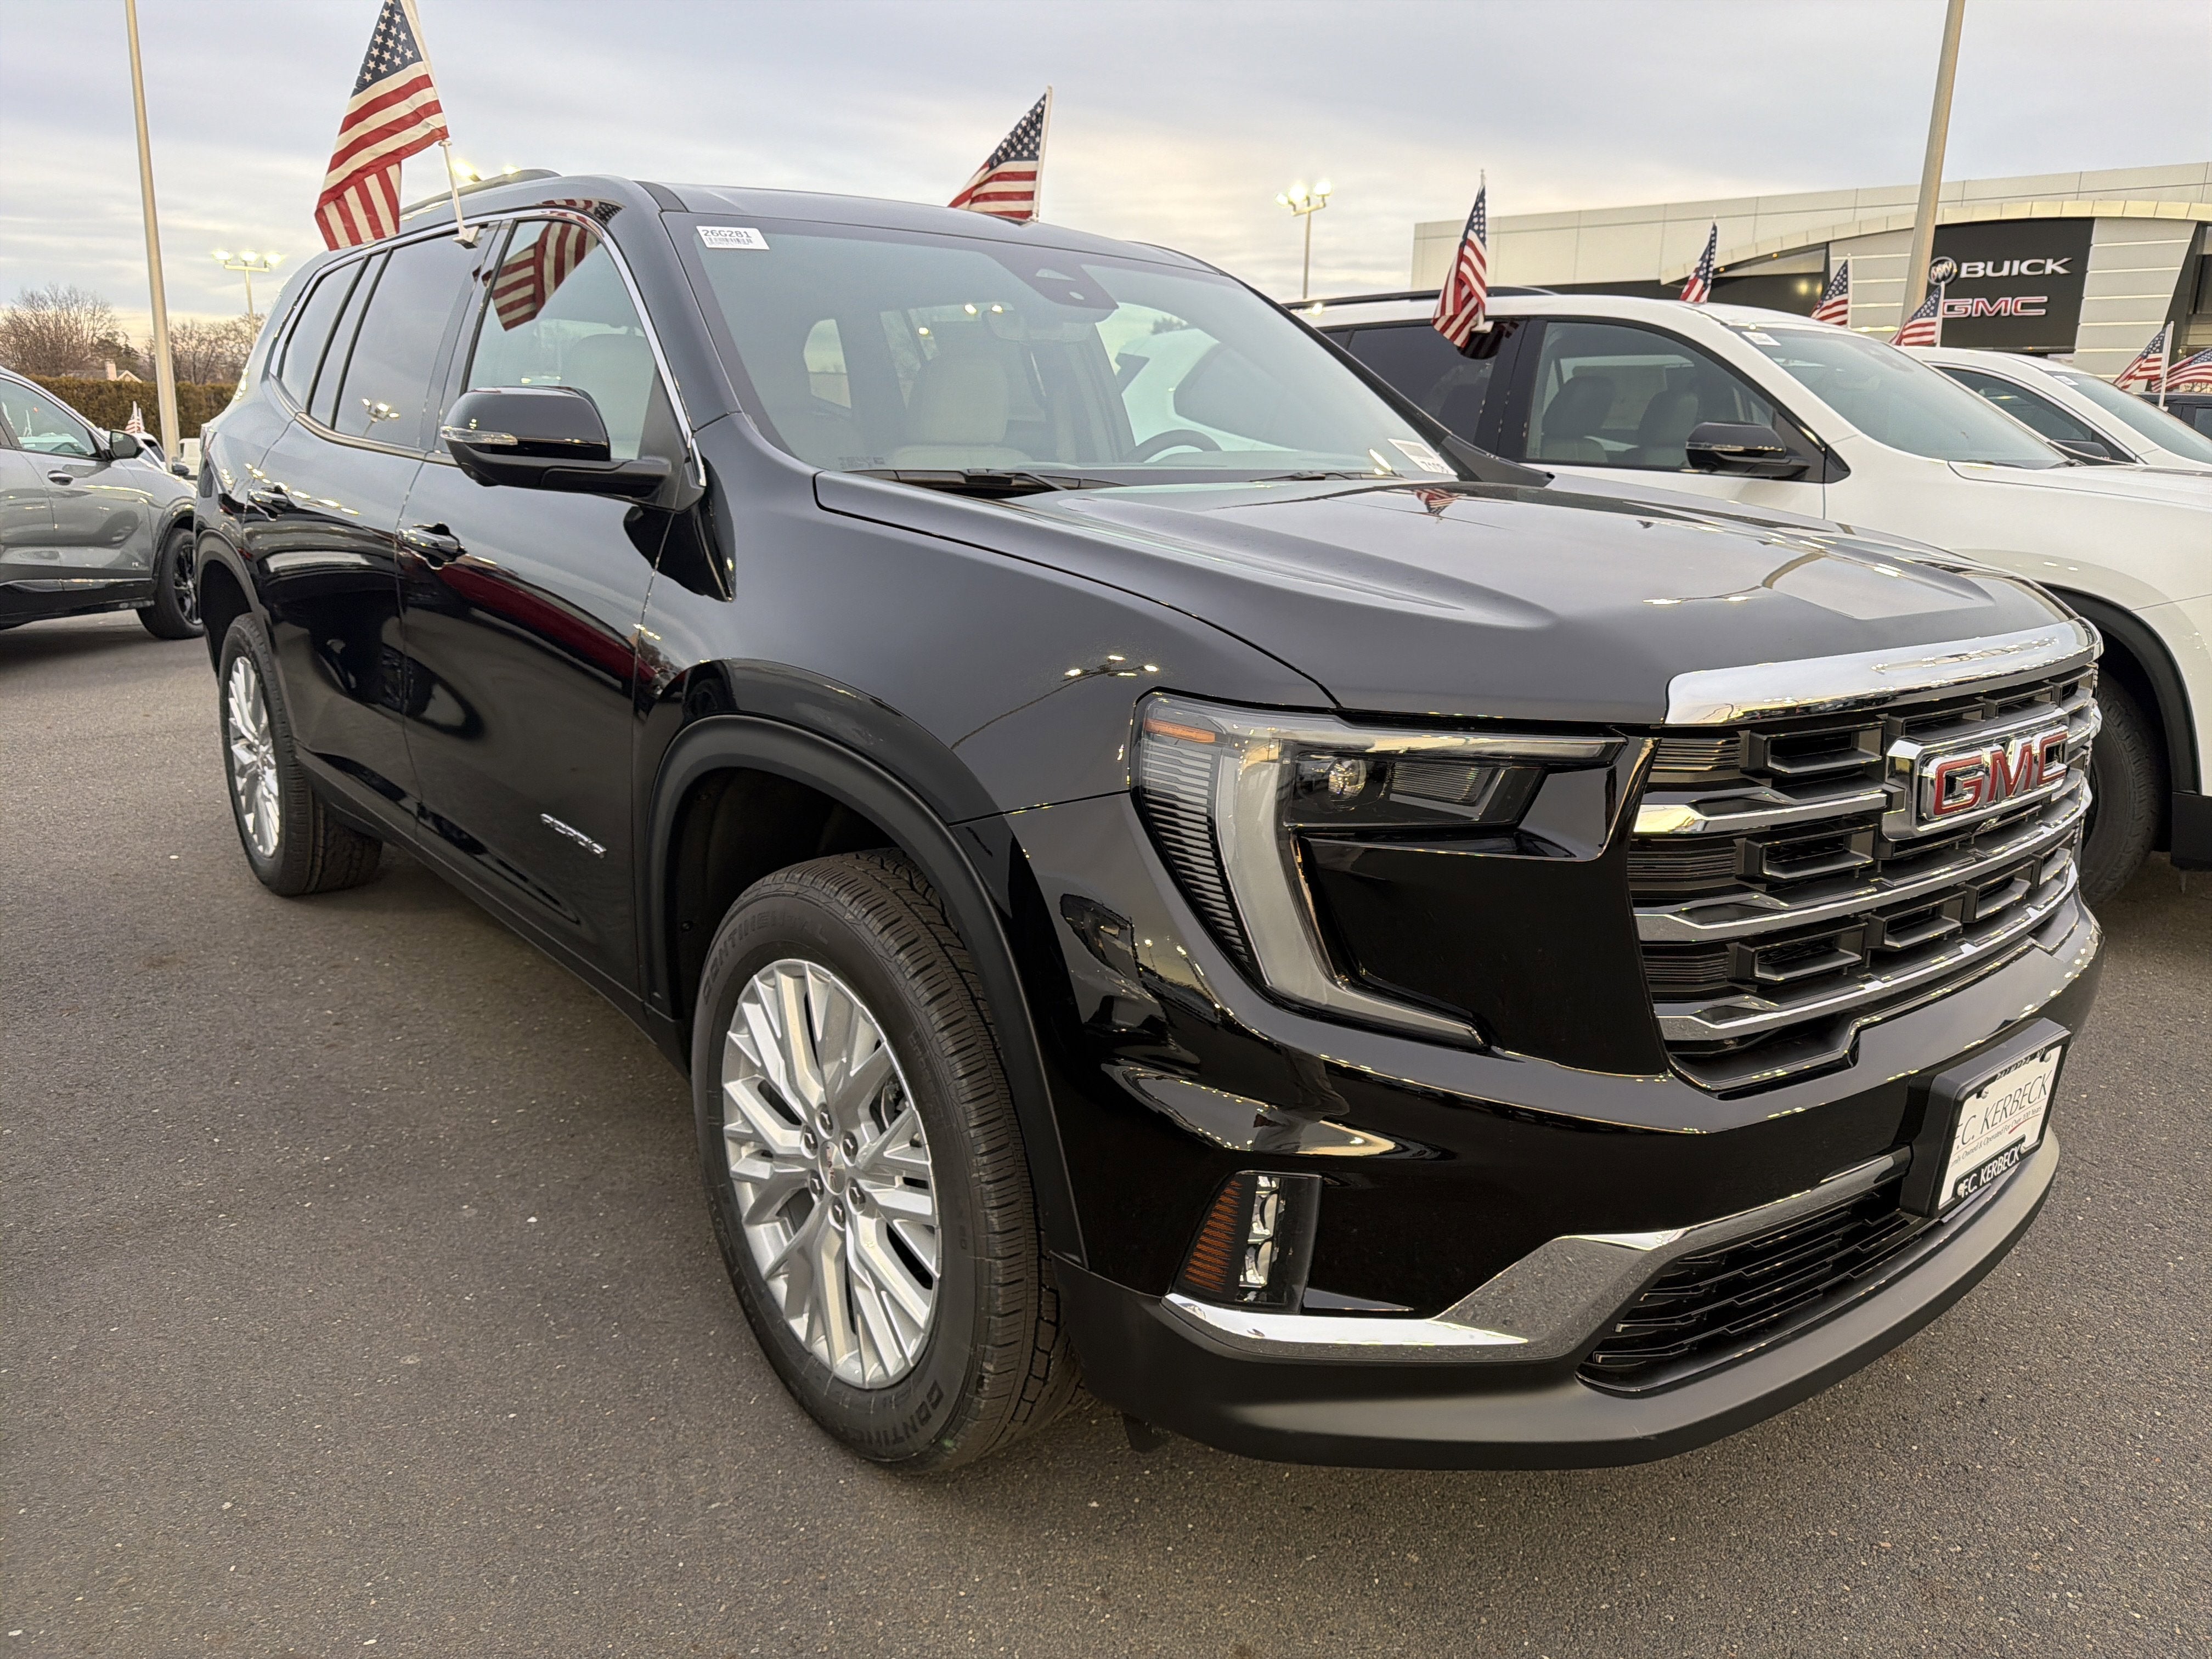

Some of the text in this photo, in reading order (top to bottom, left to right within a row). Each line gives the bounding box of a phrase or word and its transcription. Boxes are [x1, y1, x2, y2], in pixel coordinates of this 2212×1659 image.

[702, 229, 752, 238] 26G281
[1960, 257, 2072, 278] BUICK
[1943, 296, 2048, 318] GMC
[1928, 725, 2069, 817] GMC
[1980, 1069, 2053, 1135] KERBECK
[1979, 1144, 2021, 1186] KERBECK
